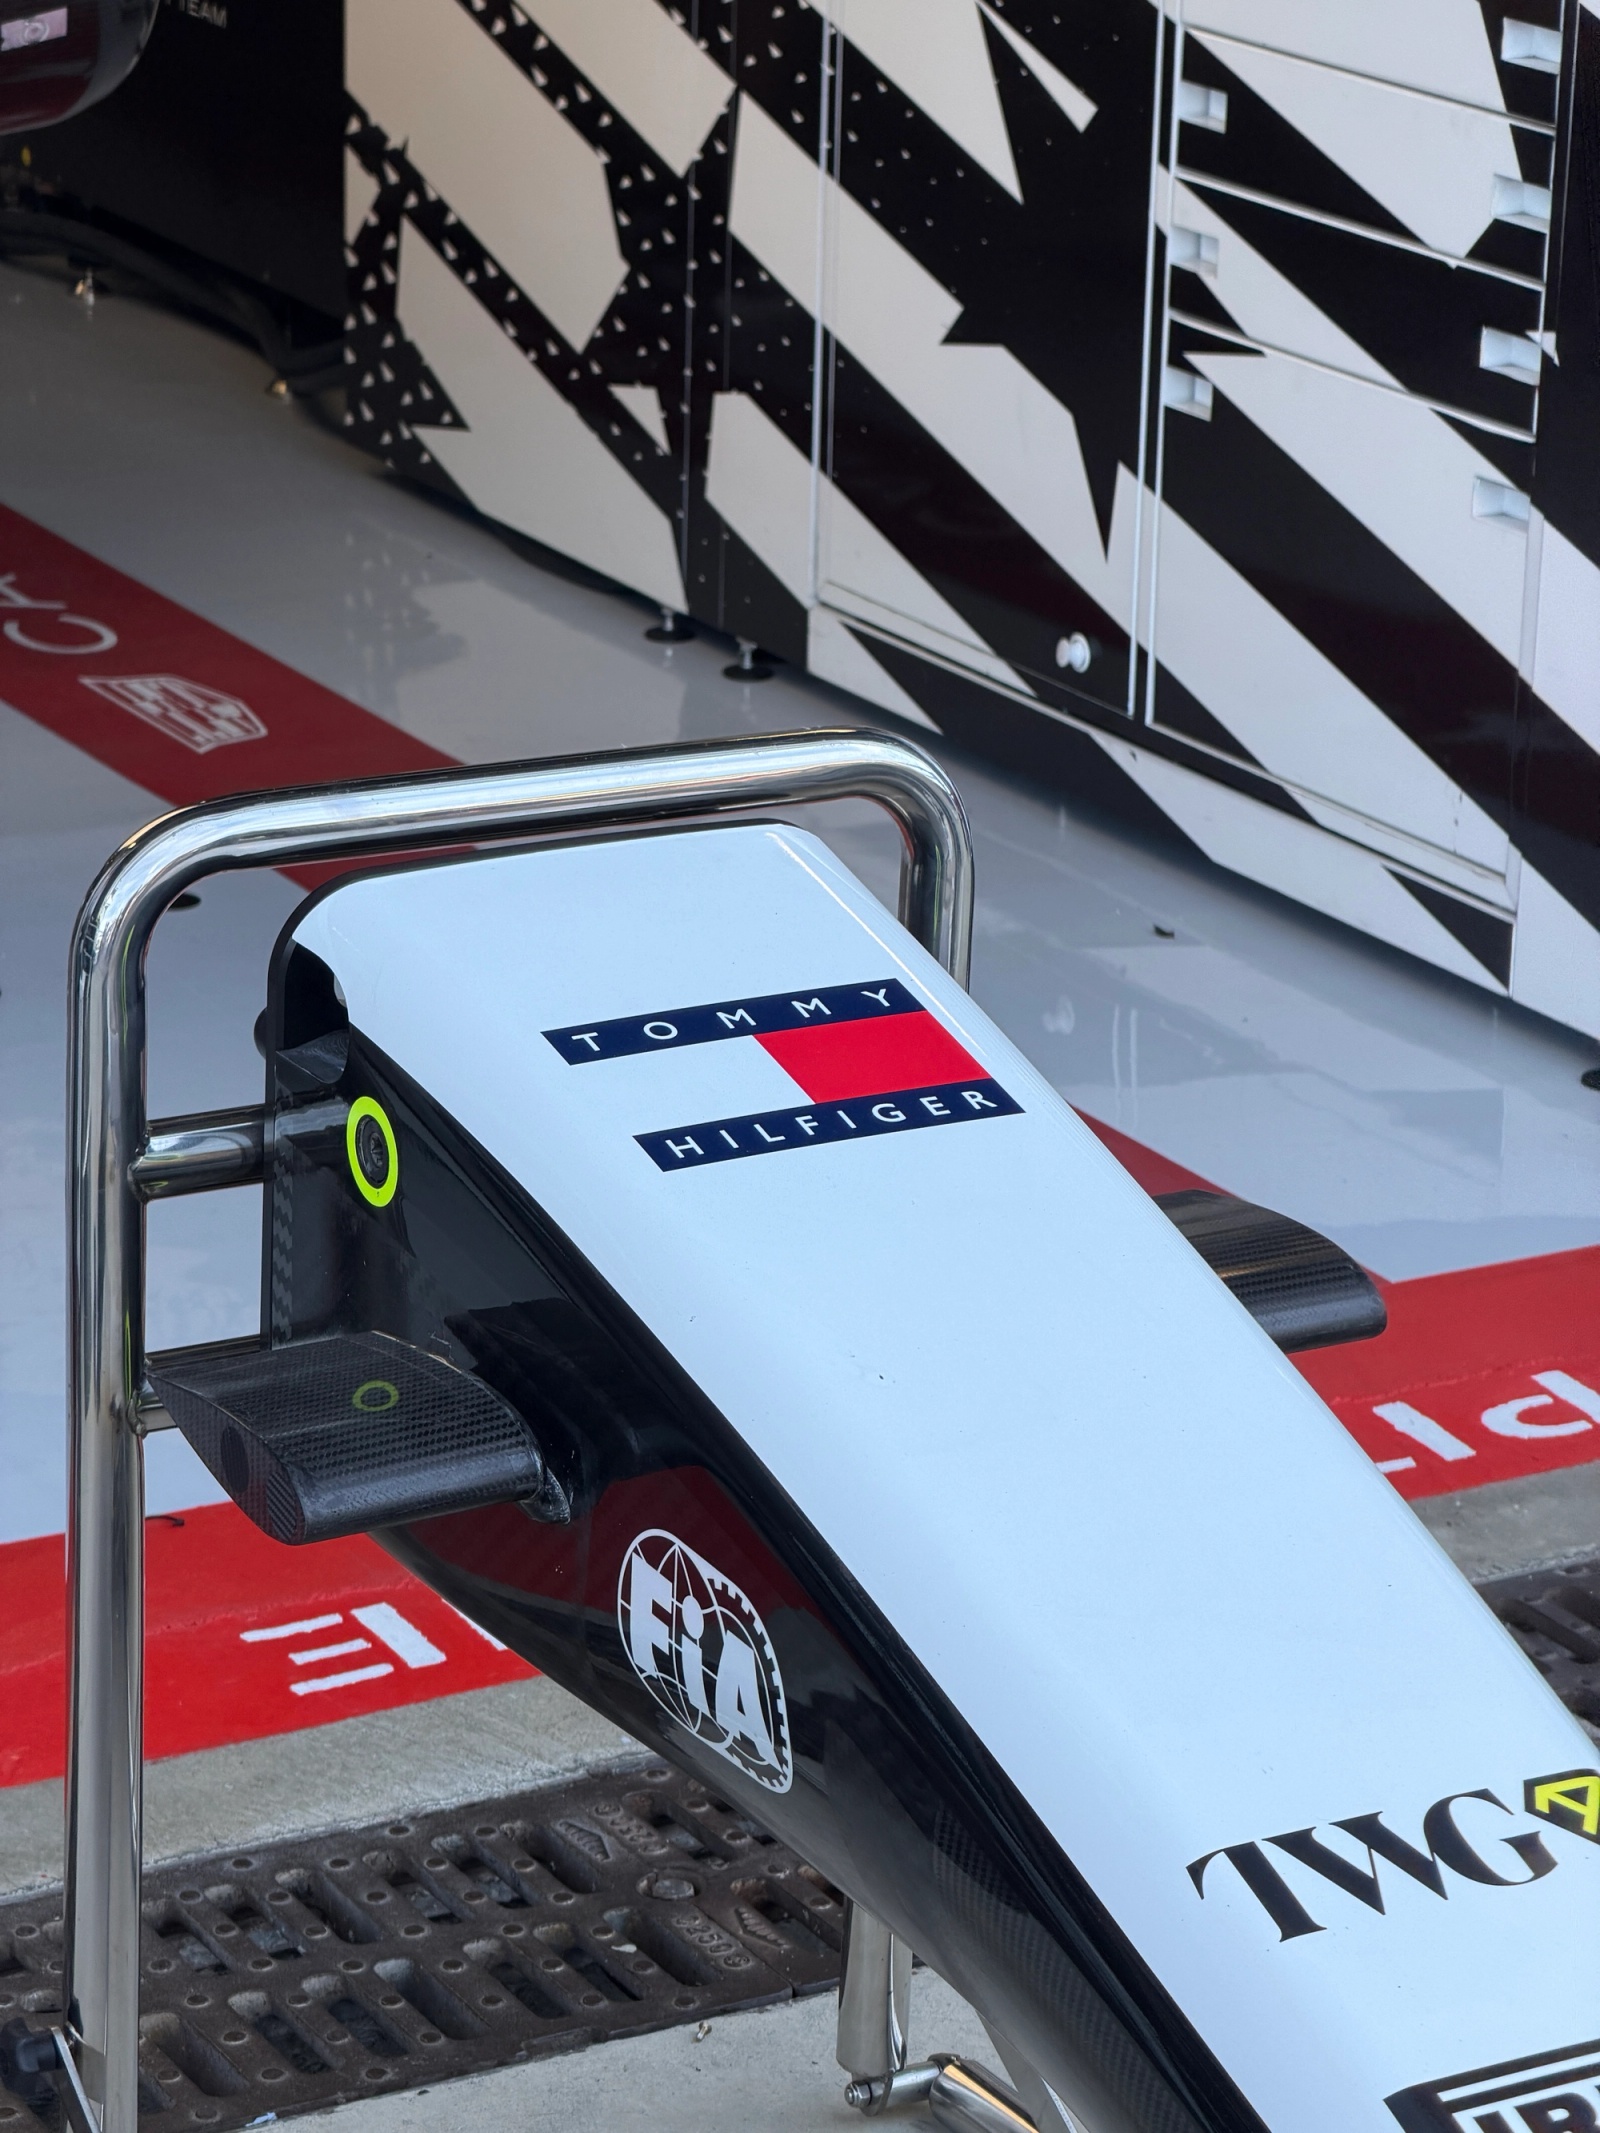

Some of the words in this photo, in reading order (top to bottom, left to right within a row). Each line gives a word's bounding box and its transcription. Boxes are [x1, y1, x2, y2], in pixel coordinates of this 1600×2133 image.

[571, 987, 891, 1052] TOMMY
[665, 1089, 999, 1160] HILFIGER
[1185, 1787, 1559, 1943] TWG
